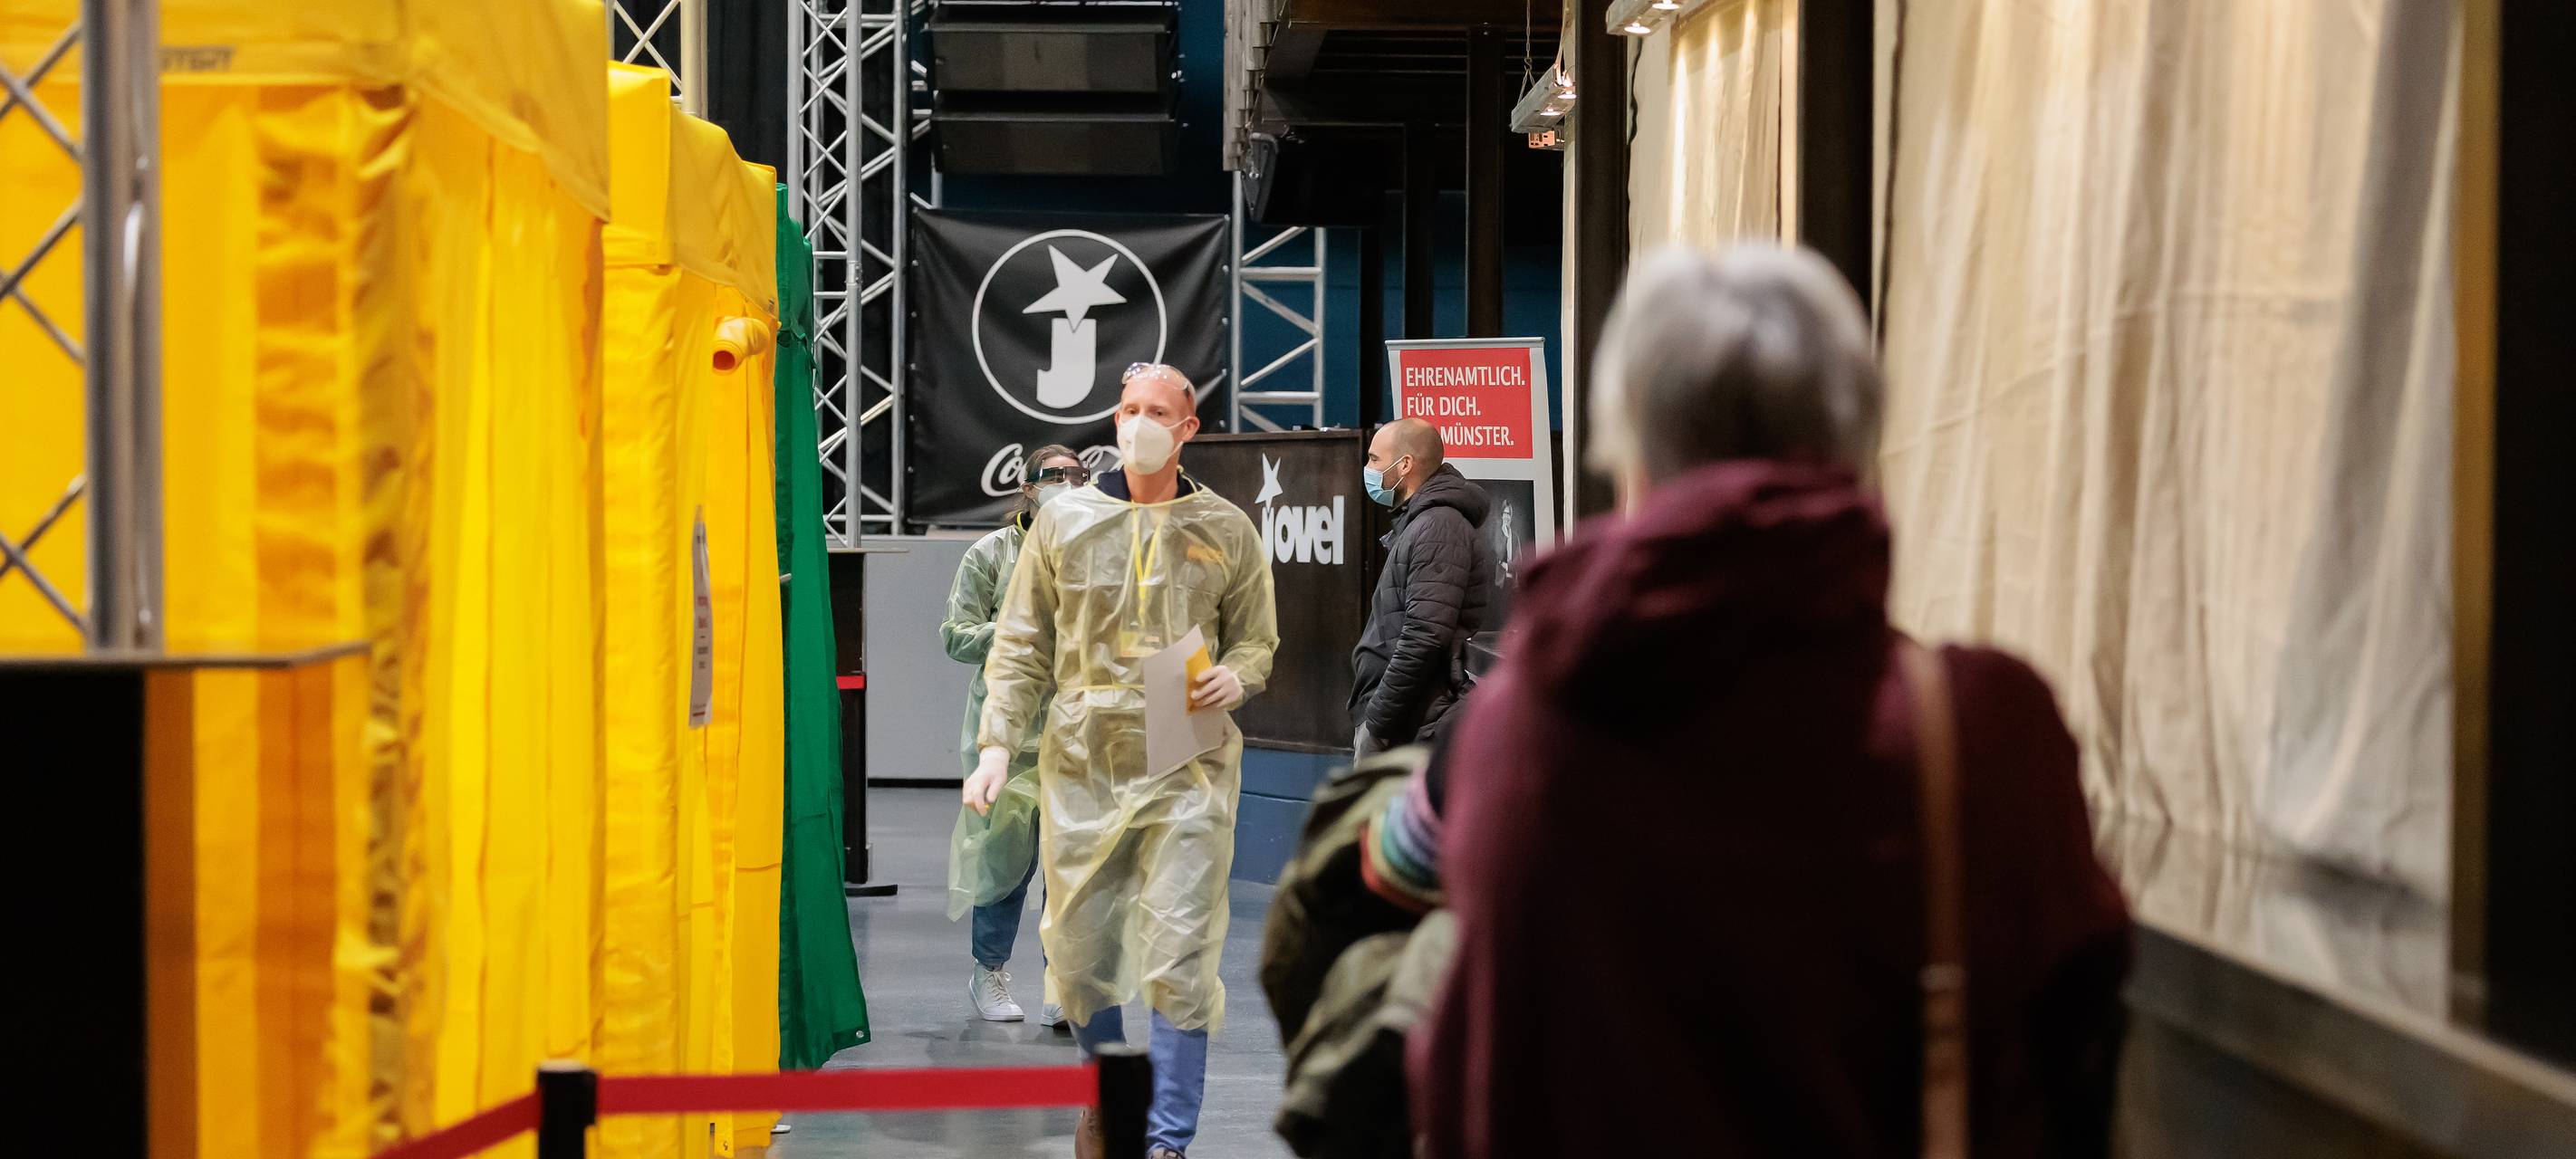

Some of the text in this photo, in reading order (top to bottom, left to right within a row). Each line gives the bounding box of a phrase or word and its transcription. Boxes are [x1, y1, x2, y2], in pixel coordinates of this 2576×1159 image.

[1406, 366, 1525, 387] EHRENAMTLICH.
[1407, 393, 1482, 417] FÜR DICH.
[1440, 422, 1514, 446] MÜNSTER.
